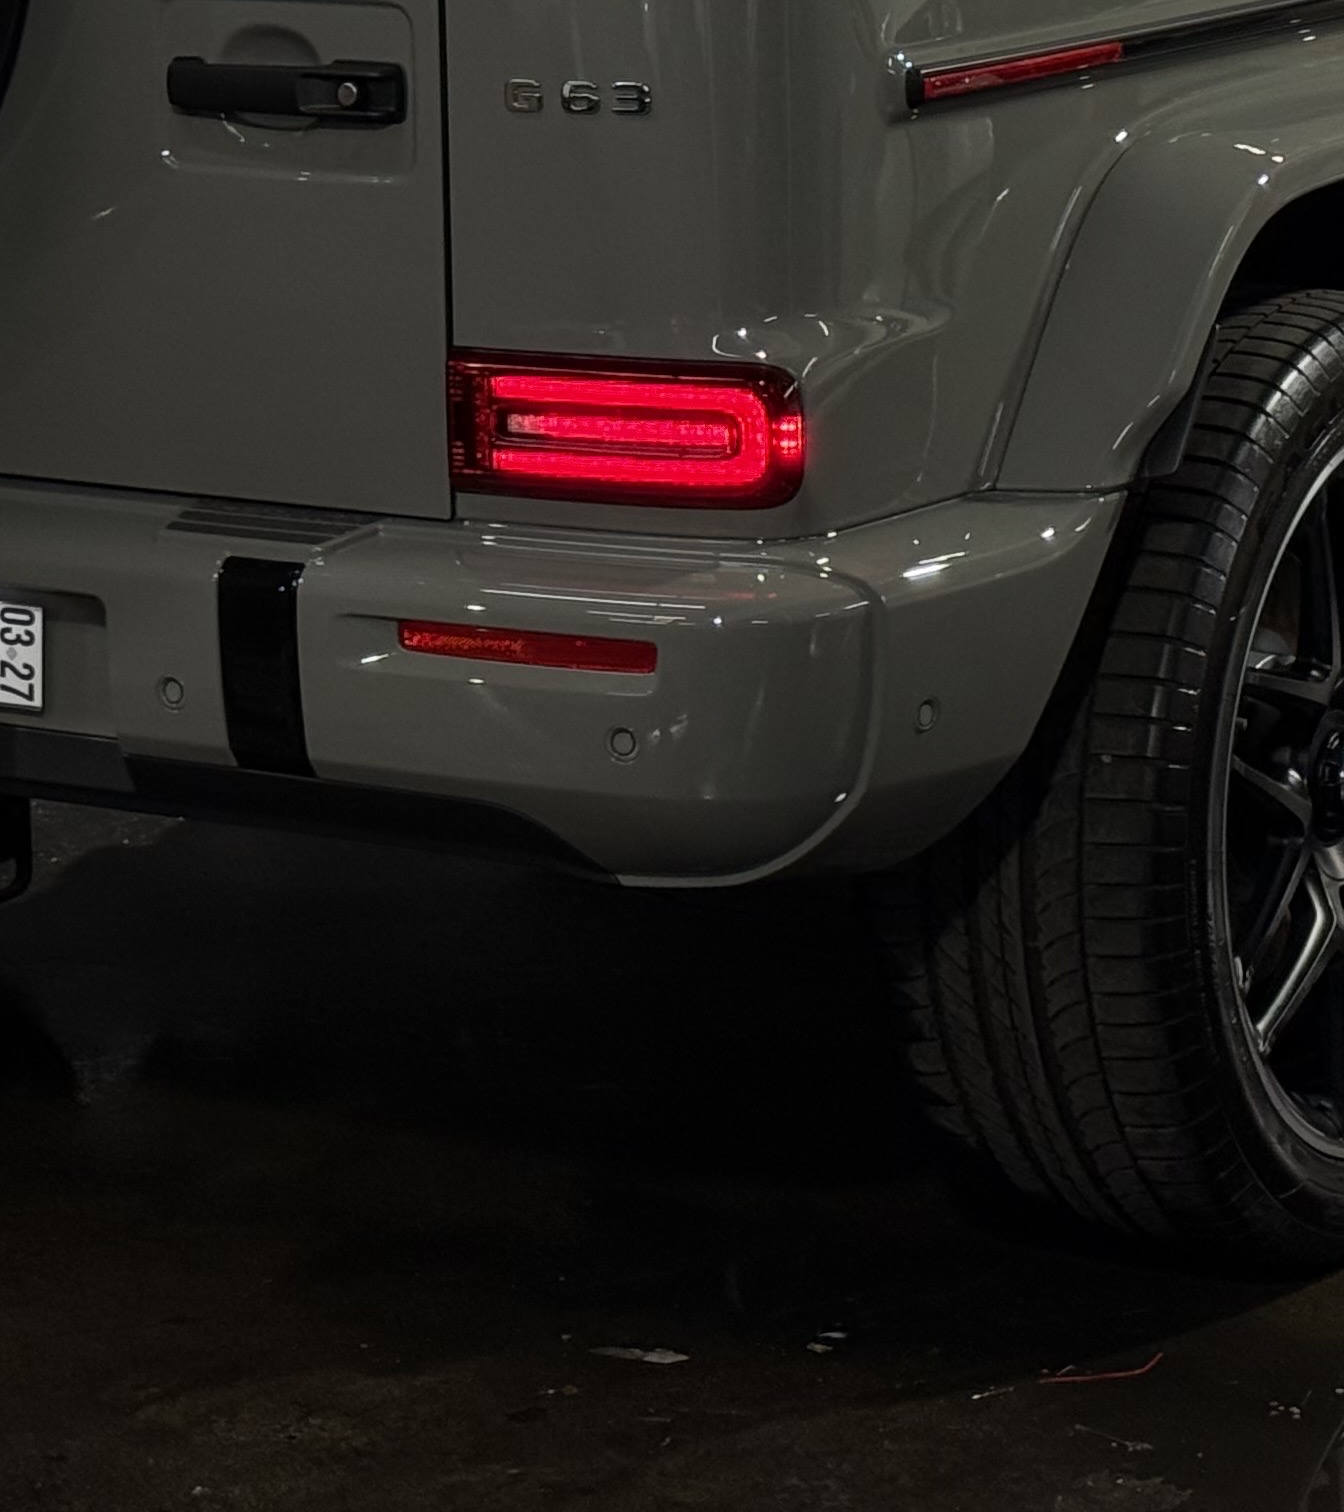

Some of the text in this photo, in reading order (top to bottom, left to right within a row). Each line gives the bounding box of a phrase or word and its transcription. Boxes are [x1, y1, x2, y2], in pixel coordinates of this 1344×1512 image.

[506, 78, 652, 115] G 63
[0, 659, 37, 704] 27
